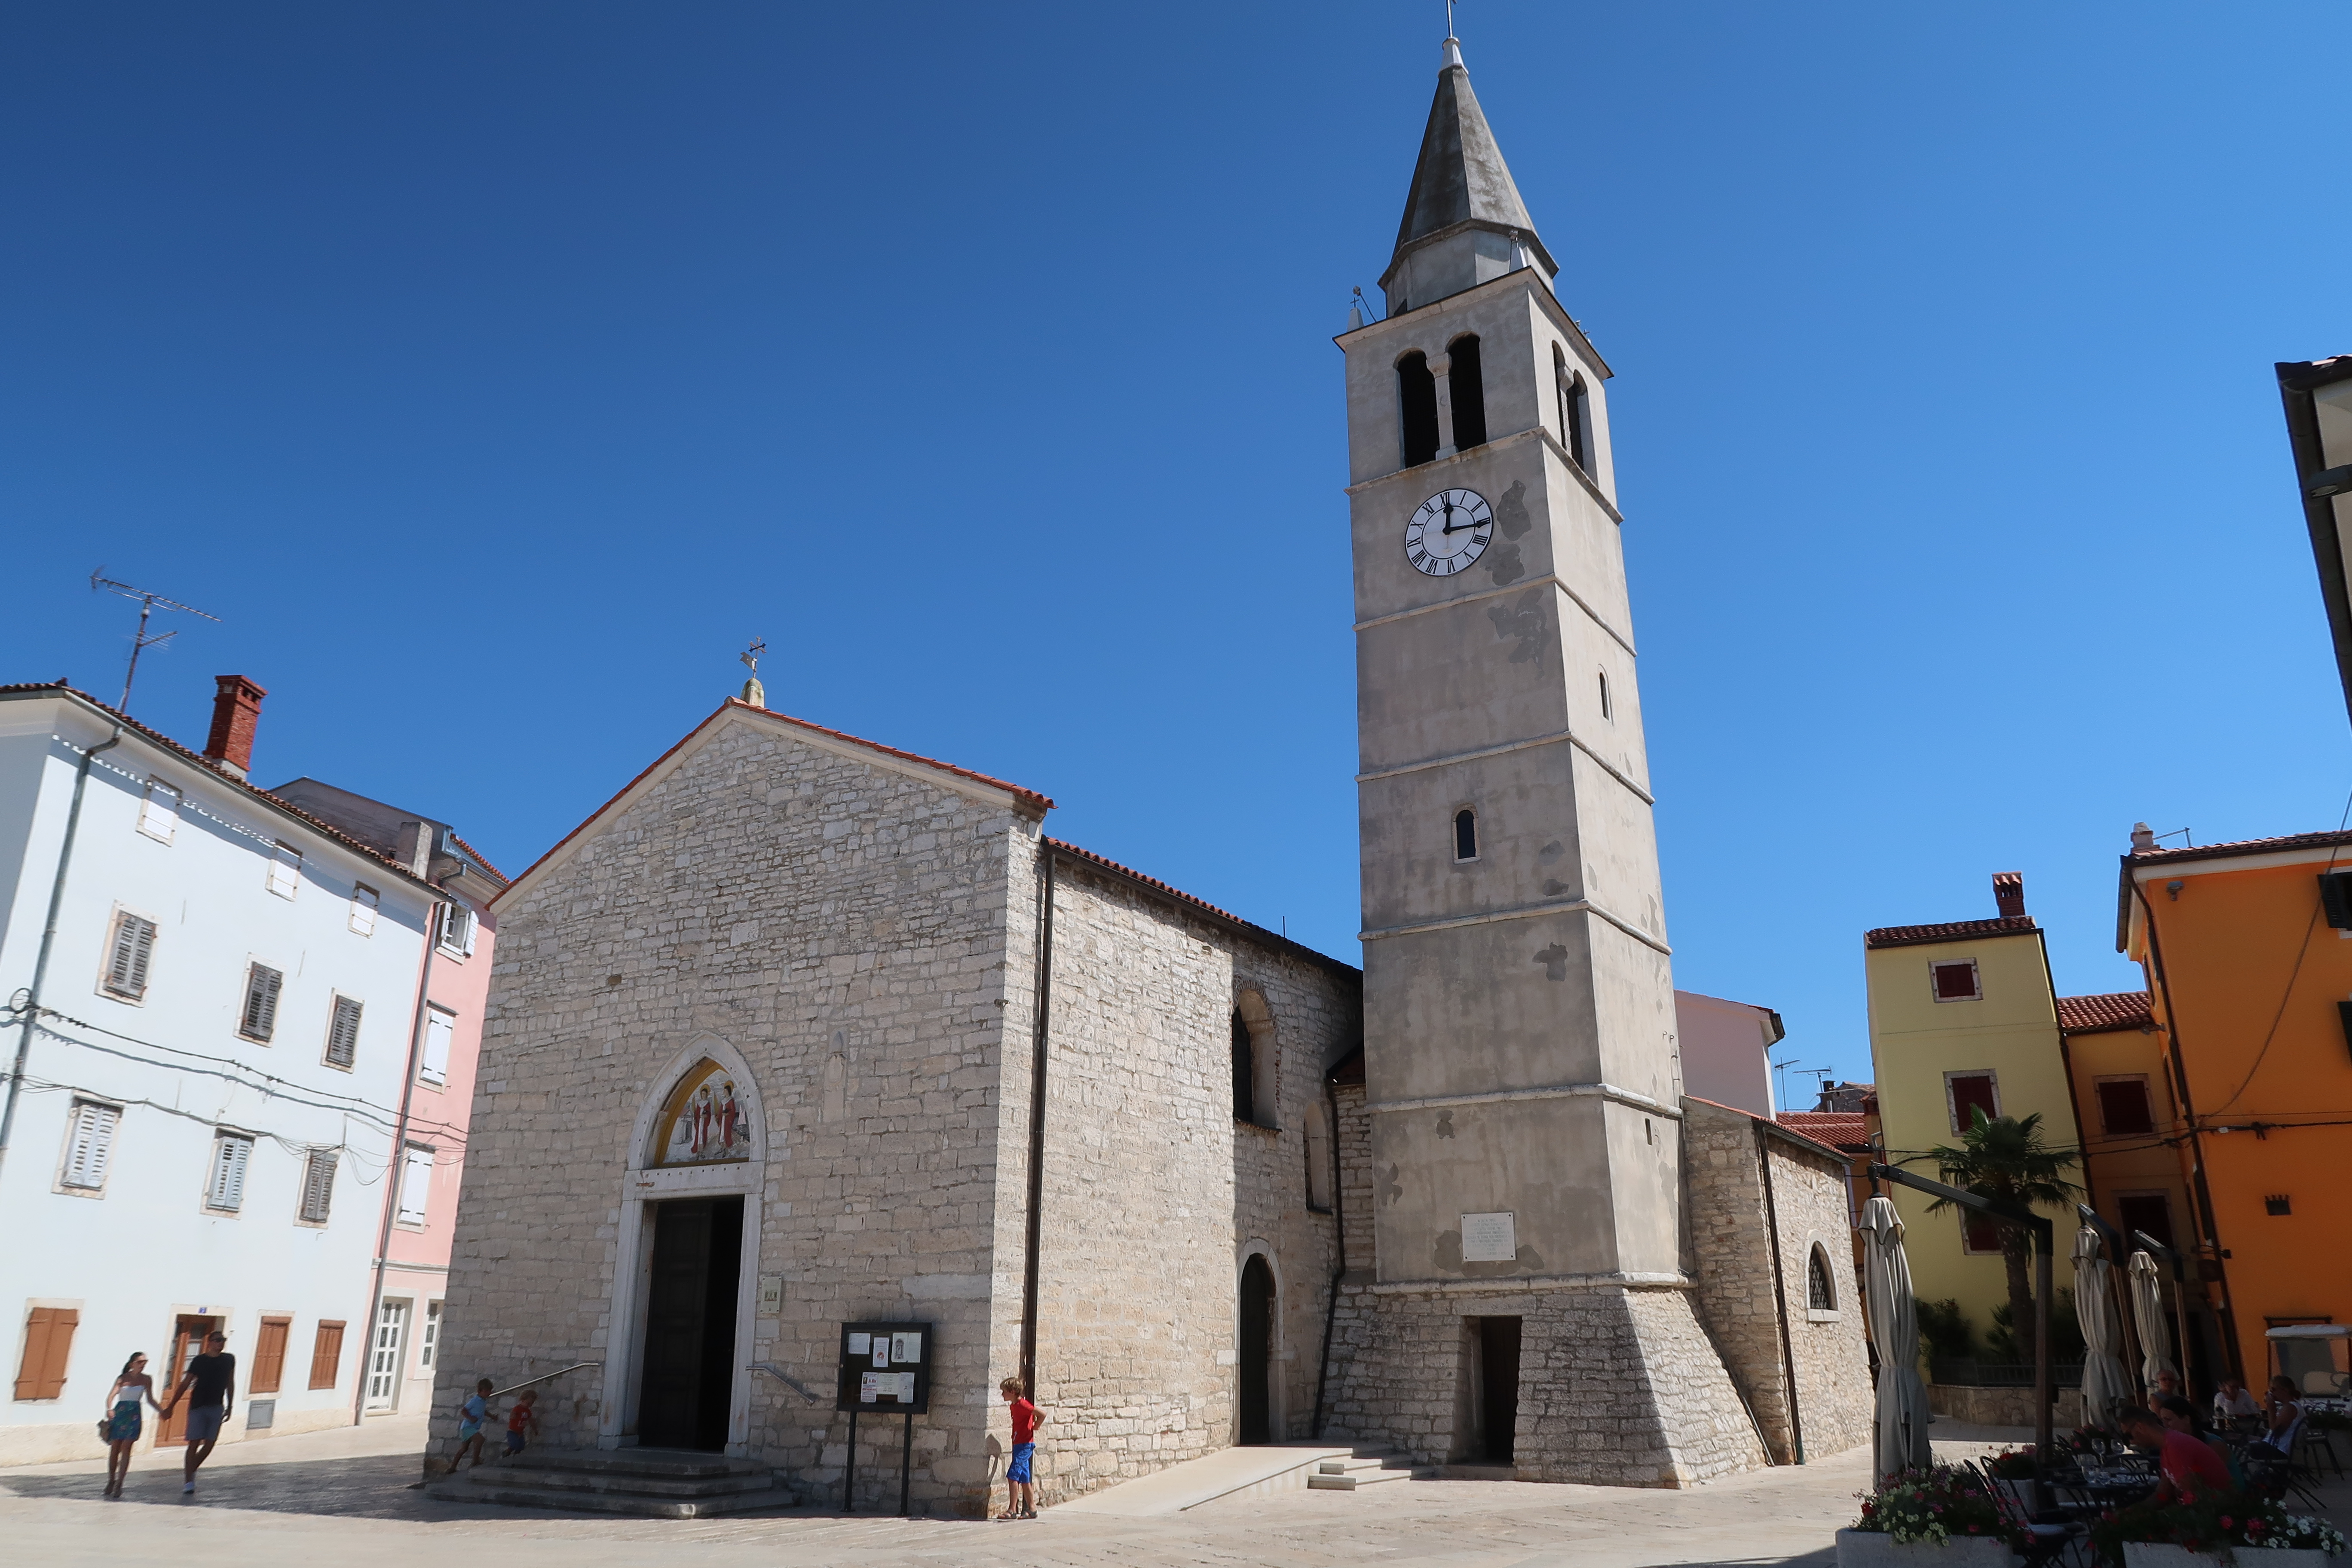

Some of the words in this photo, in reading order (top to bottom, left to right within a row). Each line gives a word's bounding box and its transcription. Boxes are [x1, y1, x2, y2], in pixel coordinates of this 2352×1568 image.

[1440, 492, 1450, 508] XII
[1459, 492, 1467, 505] I
[1422, 502, 1435, 517] XI
[1470, 500, 1484, 513] II
[1410, 520, 1424, 530] X
[1407, 536, 1421, 548] IX
[1472, 534, 1488, 546] IIII
[1411, 549, 1427, 567] VIII
[1464, 551, 1474, 563] V
[1426, 559, 1438, 574] VII
[1447, 559, 1455, 573] VI
